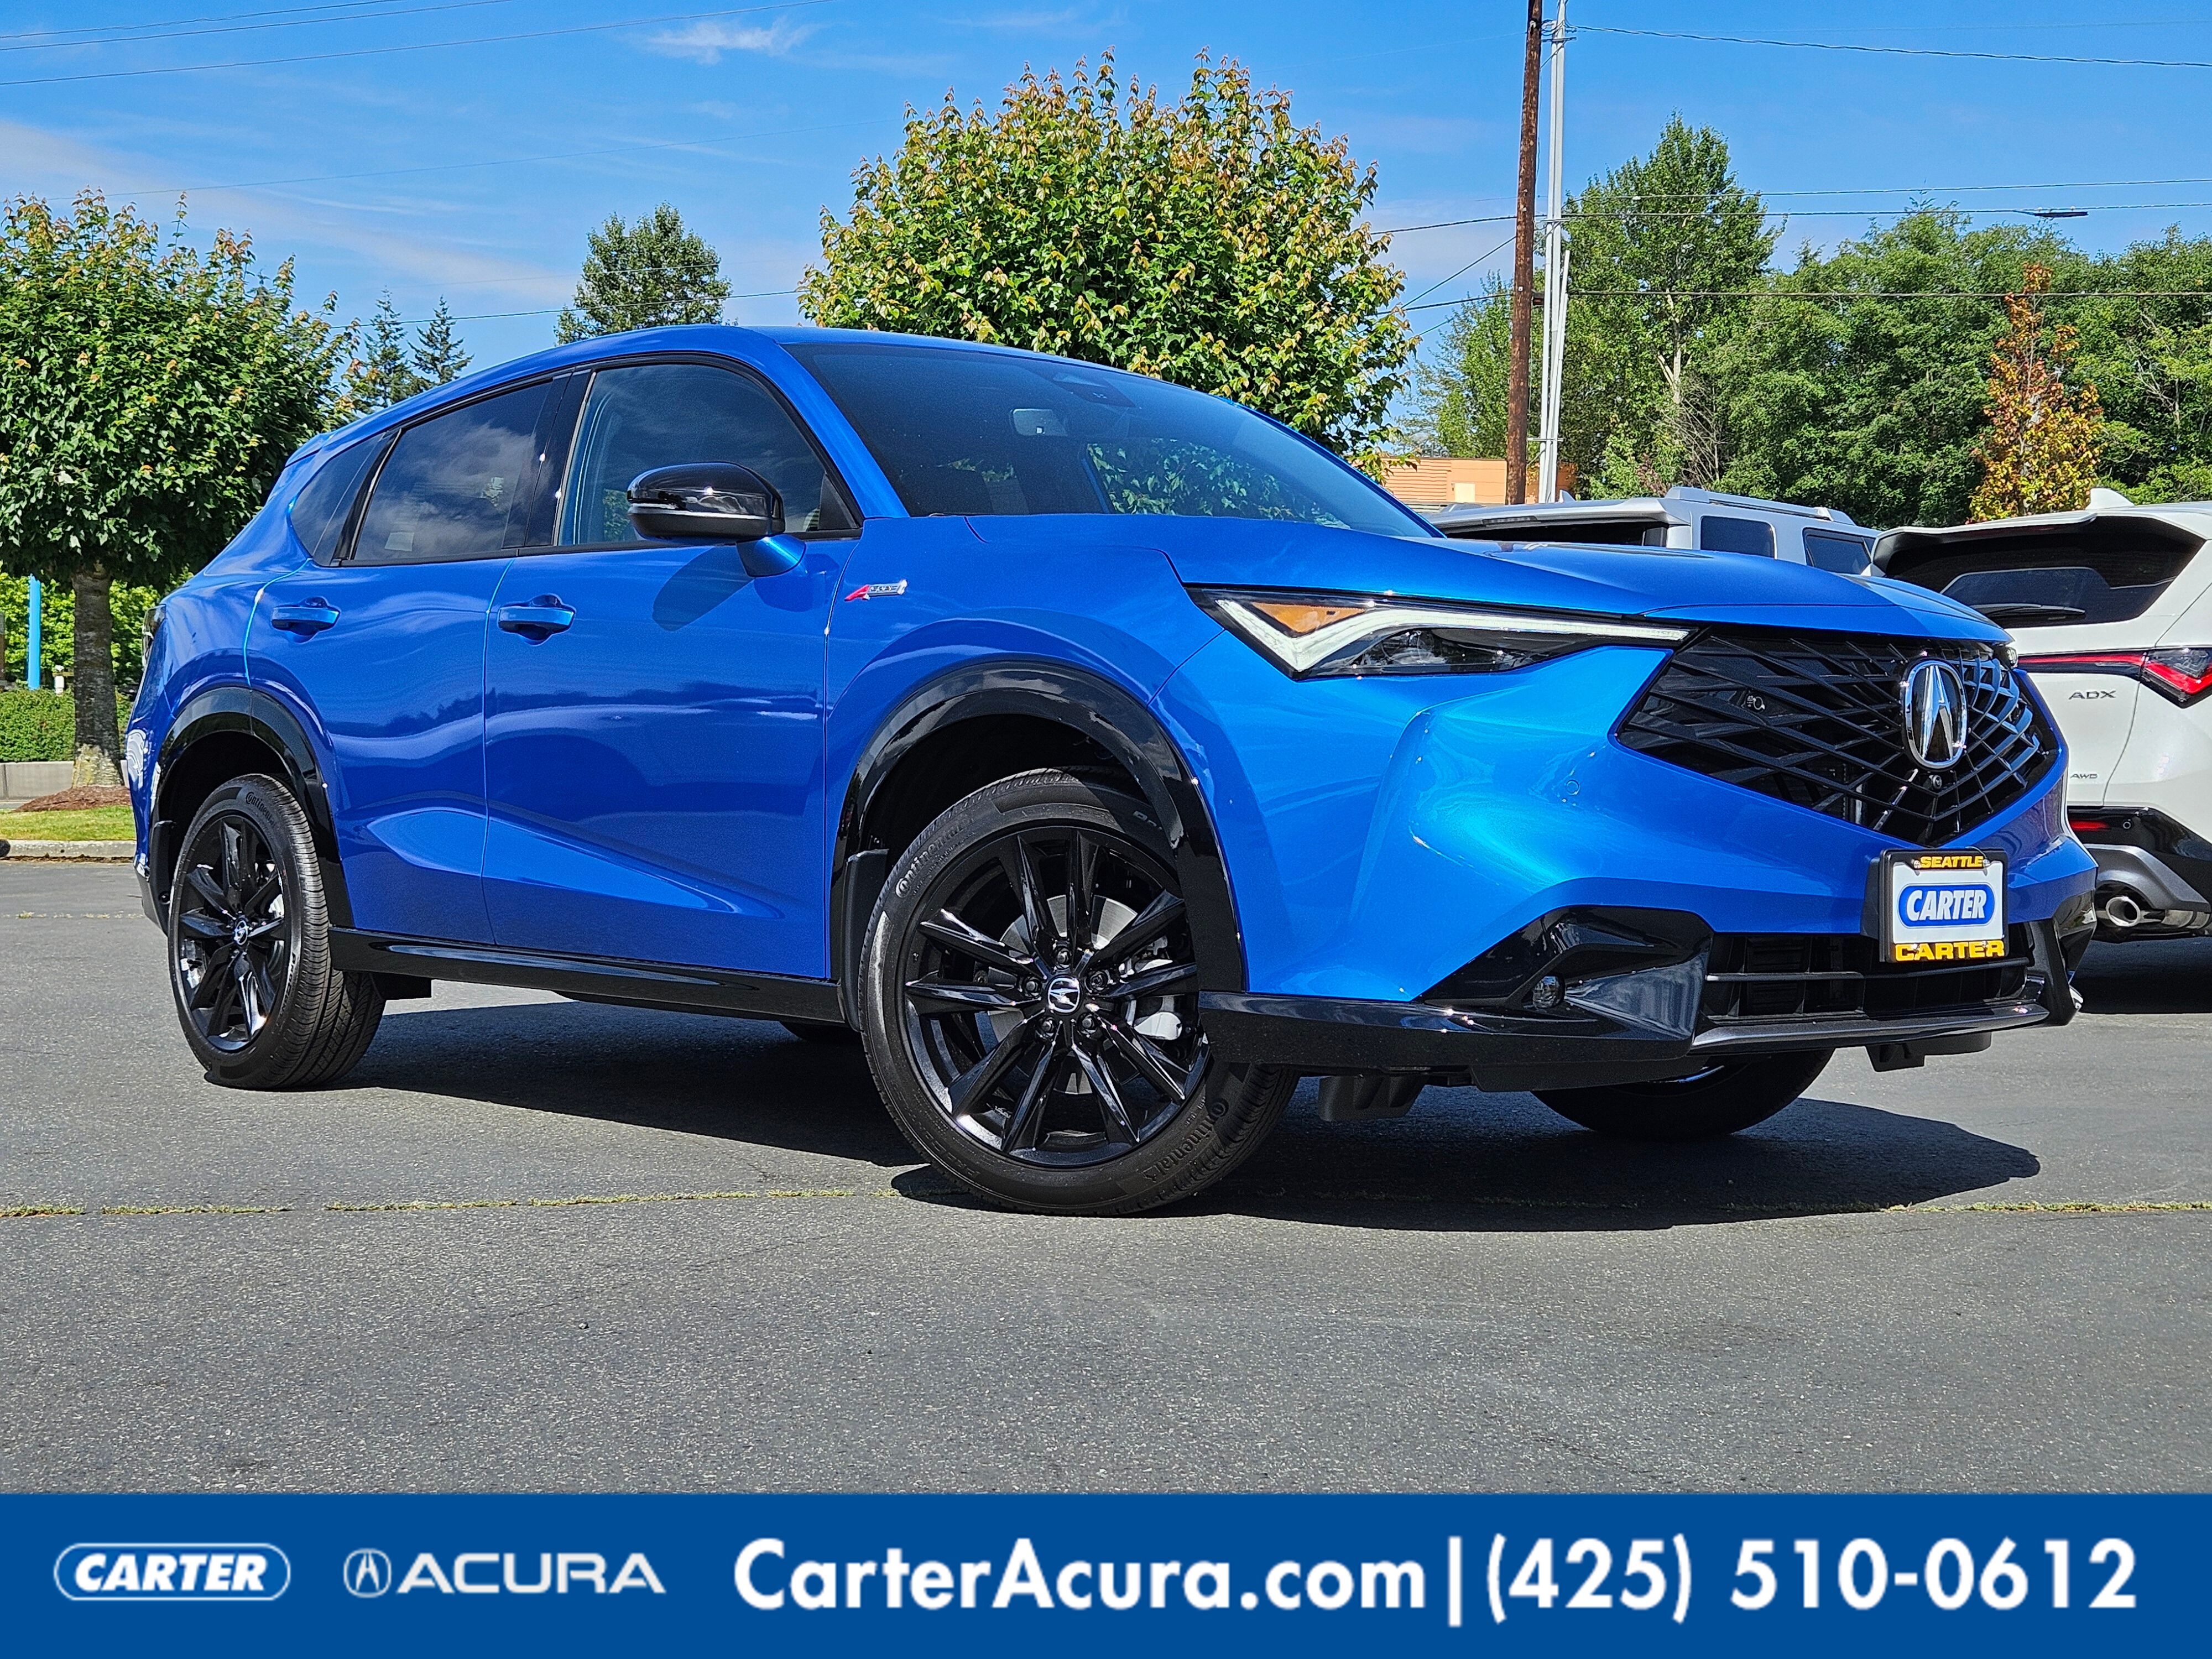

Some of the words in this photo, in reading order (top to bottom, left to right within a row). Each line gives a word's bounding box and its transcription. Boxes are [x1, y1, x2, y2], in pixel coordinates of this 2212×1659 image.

[2069, 691, 2116, 700] ADX
[1919, 856, 1984, 868] SEATTLE
[1906, 889, 1987, 921] CARTER
[1895, 940, 2005, 961] CARTER
